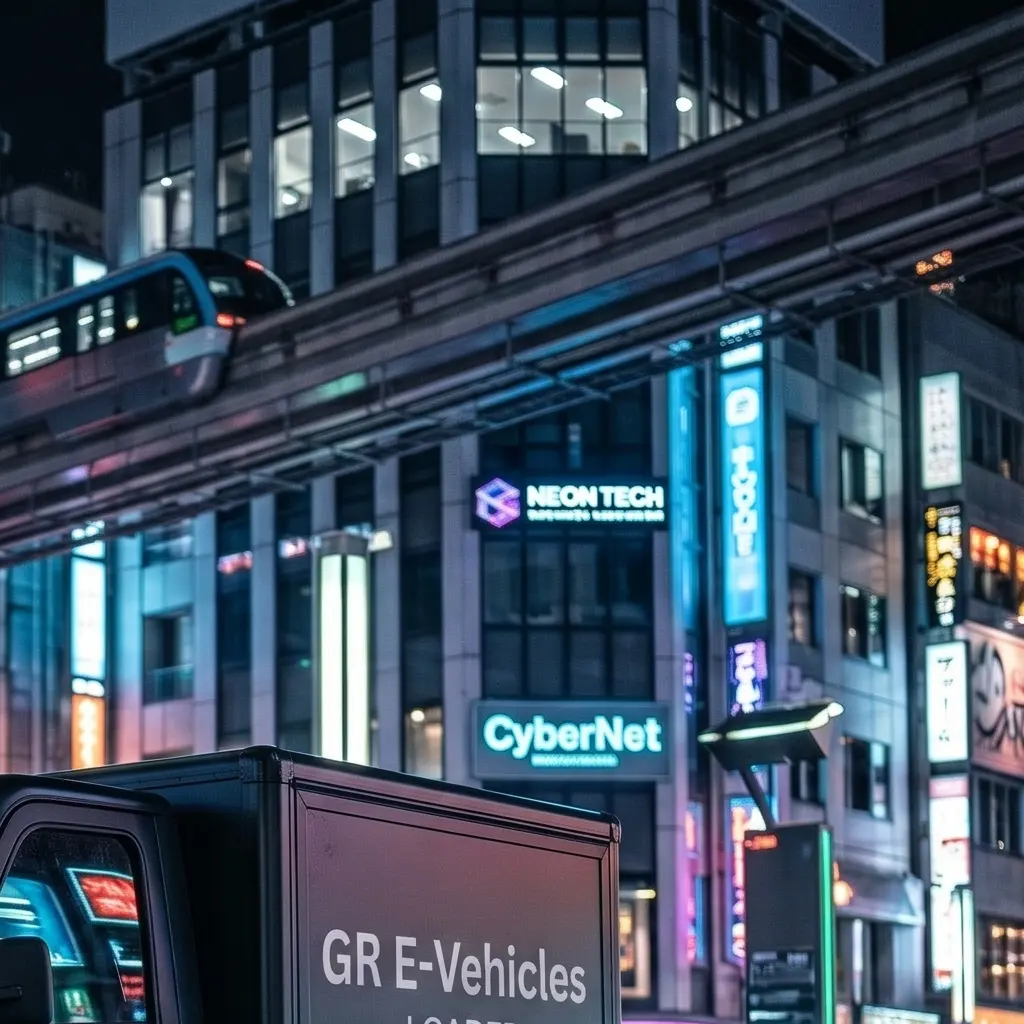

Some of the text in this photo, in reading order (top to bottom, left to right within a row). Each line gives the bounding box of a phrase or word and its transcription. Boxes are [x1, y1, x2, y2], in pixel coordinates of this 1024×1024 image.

[526, 485, 665, 508] NEON TECH
[483, 714, 662, 759] CyberNet
[322, 929, 587, 1004] GR E-Vehicles
